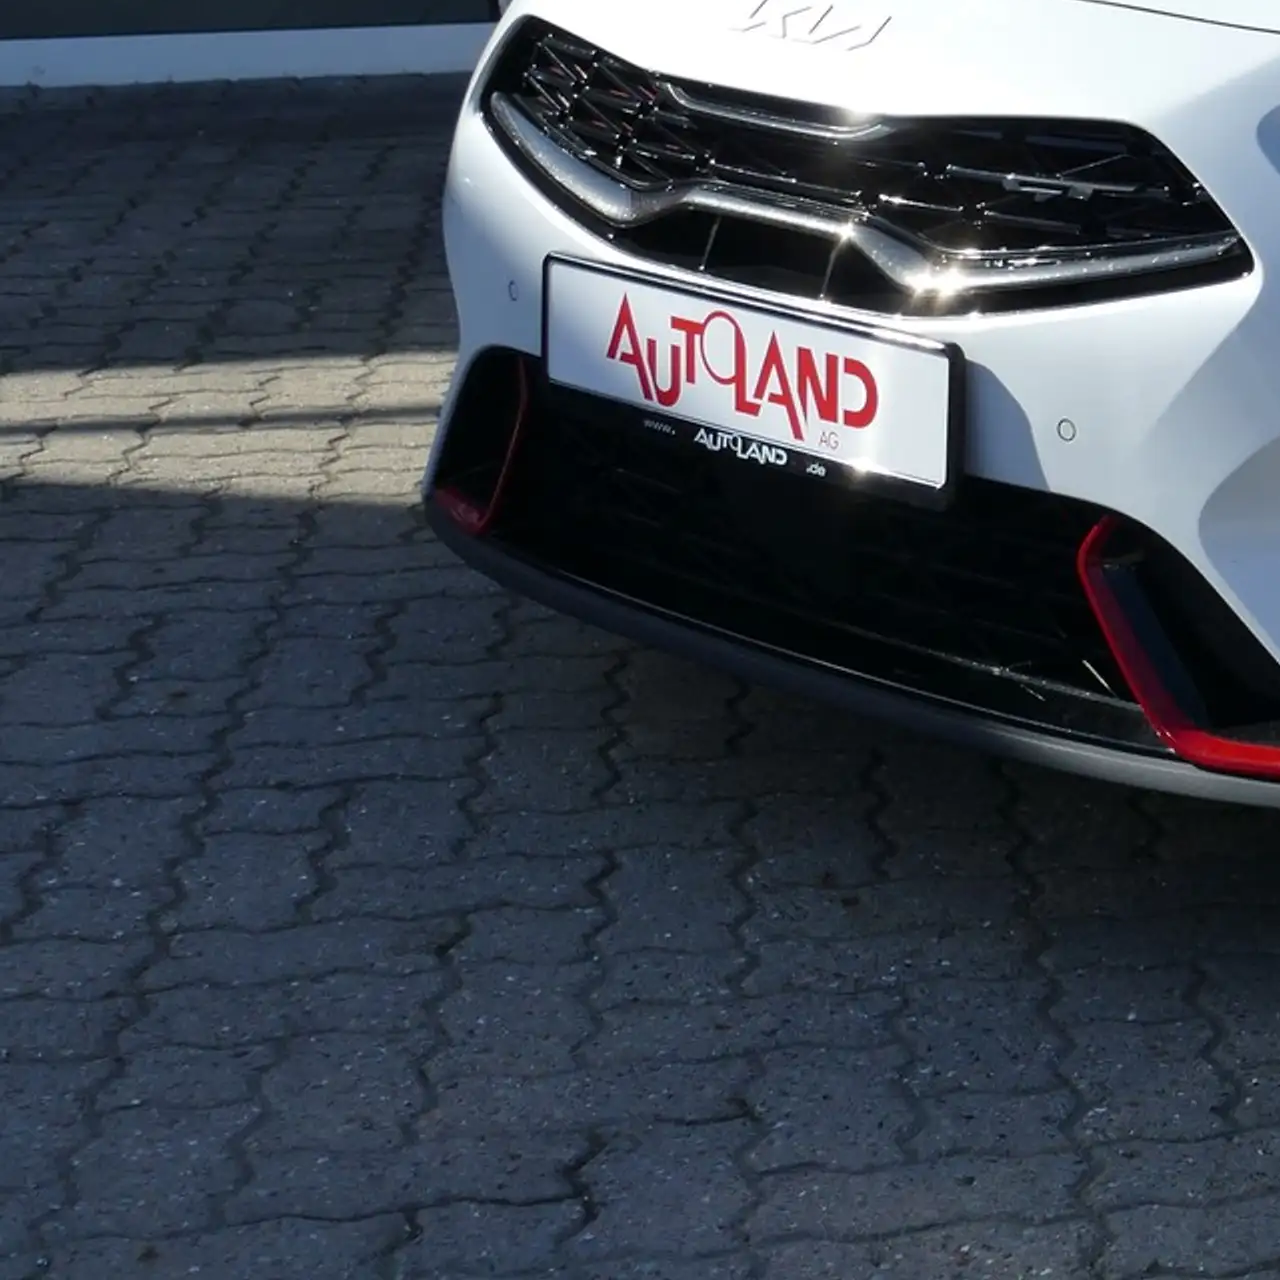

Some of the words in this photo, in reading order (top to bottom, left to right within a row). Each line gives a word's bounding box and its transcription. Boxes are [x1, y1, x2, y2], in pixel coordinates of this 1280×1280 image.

[606, 291, 880, 442] AUTOLAND
[692, 427, 789, 467] AUTOLAND
[817, 429, 840, 451] AG
